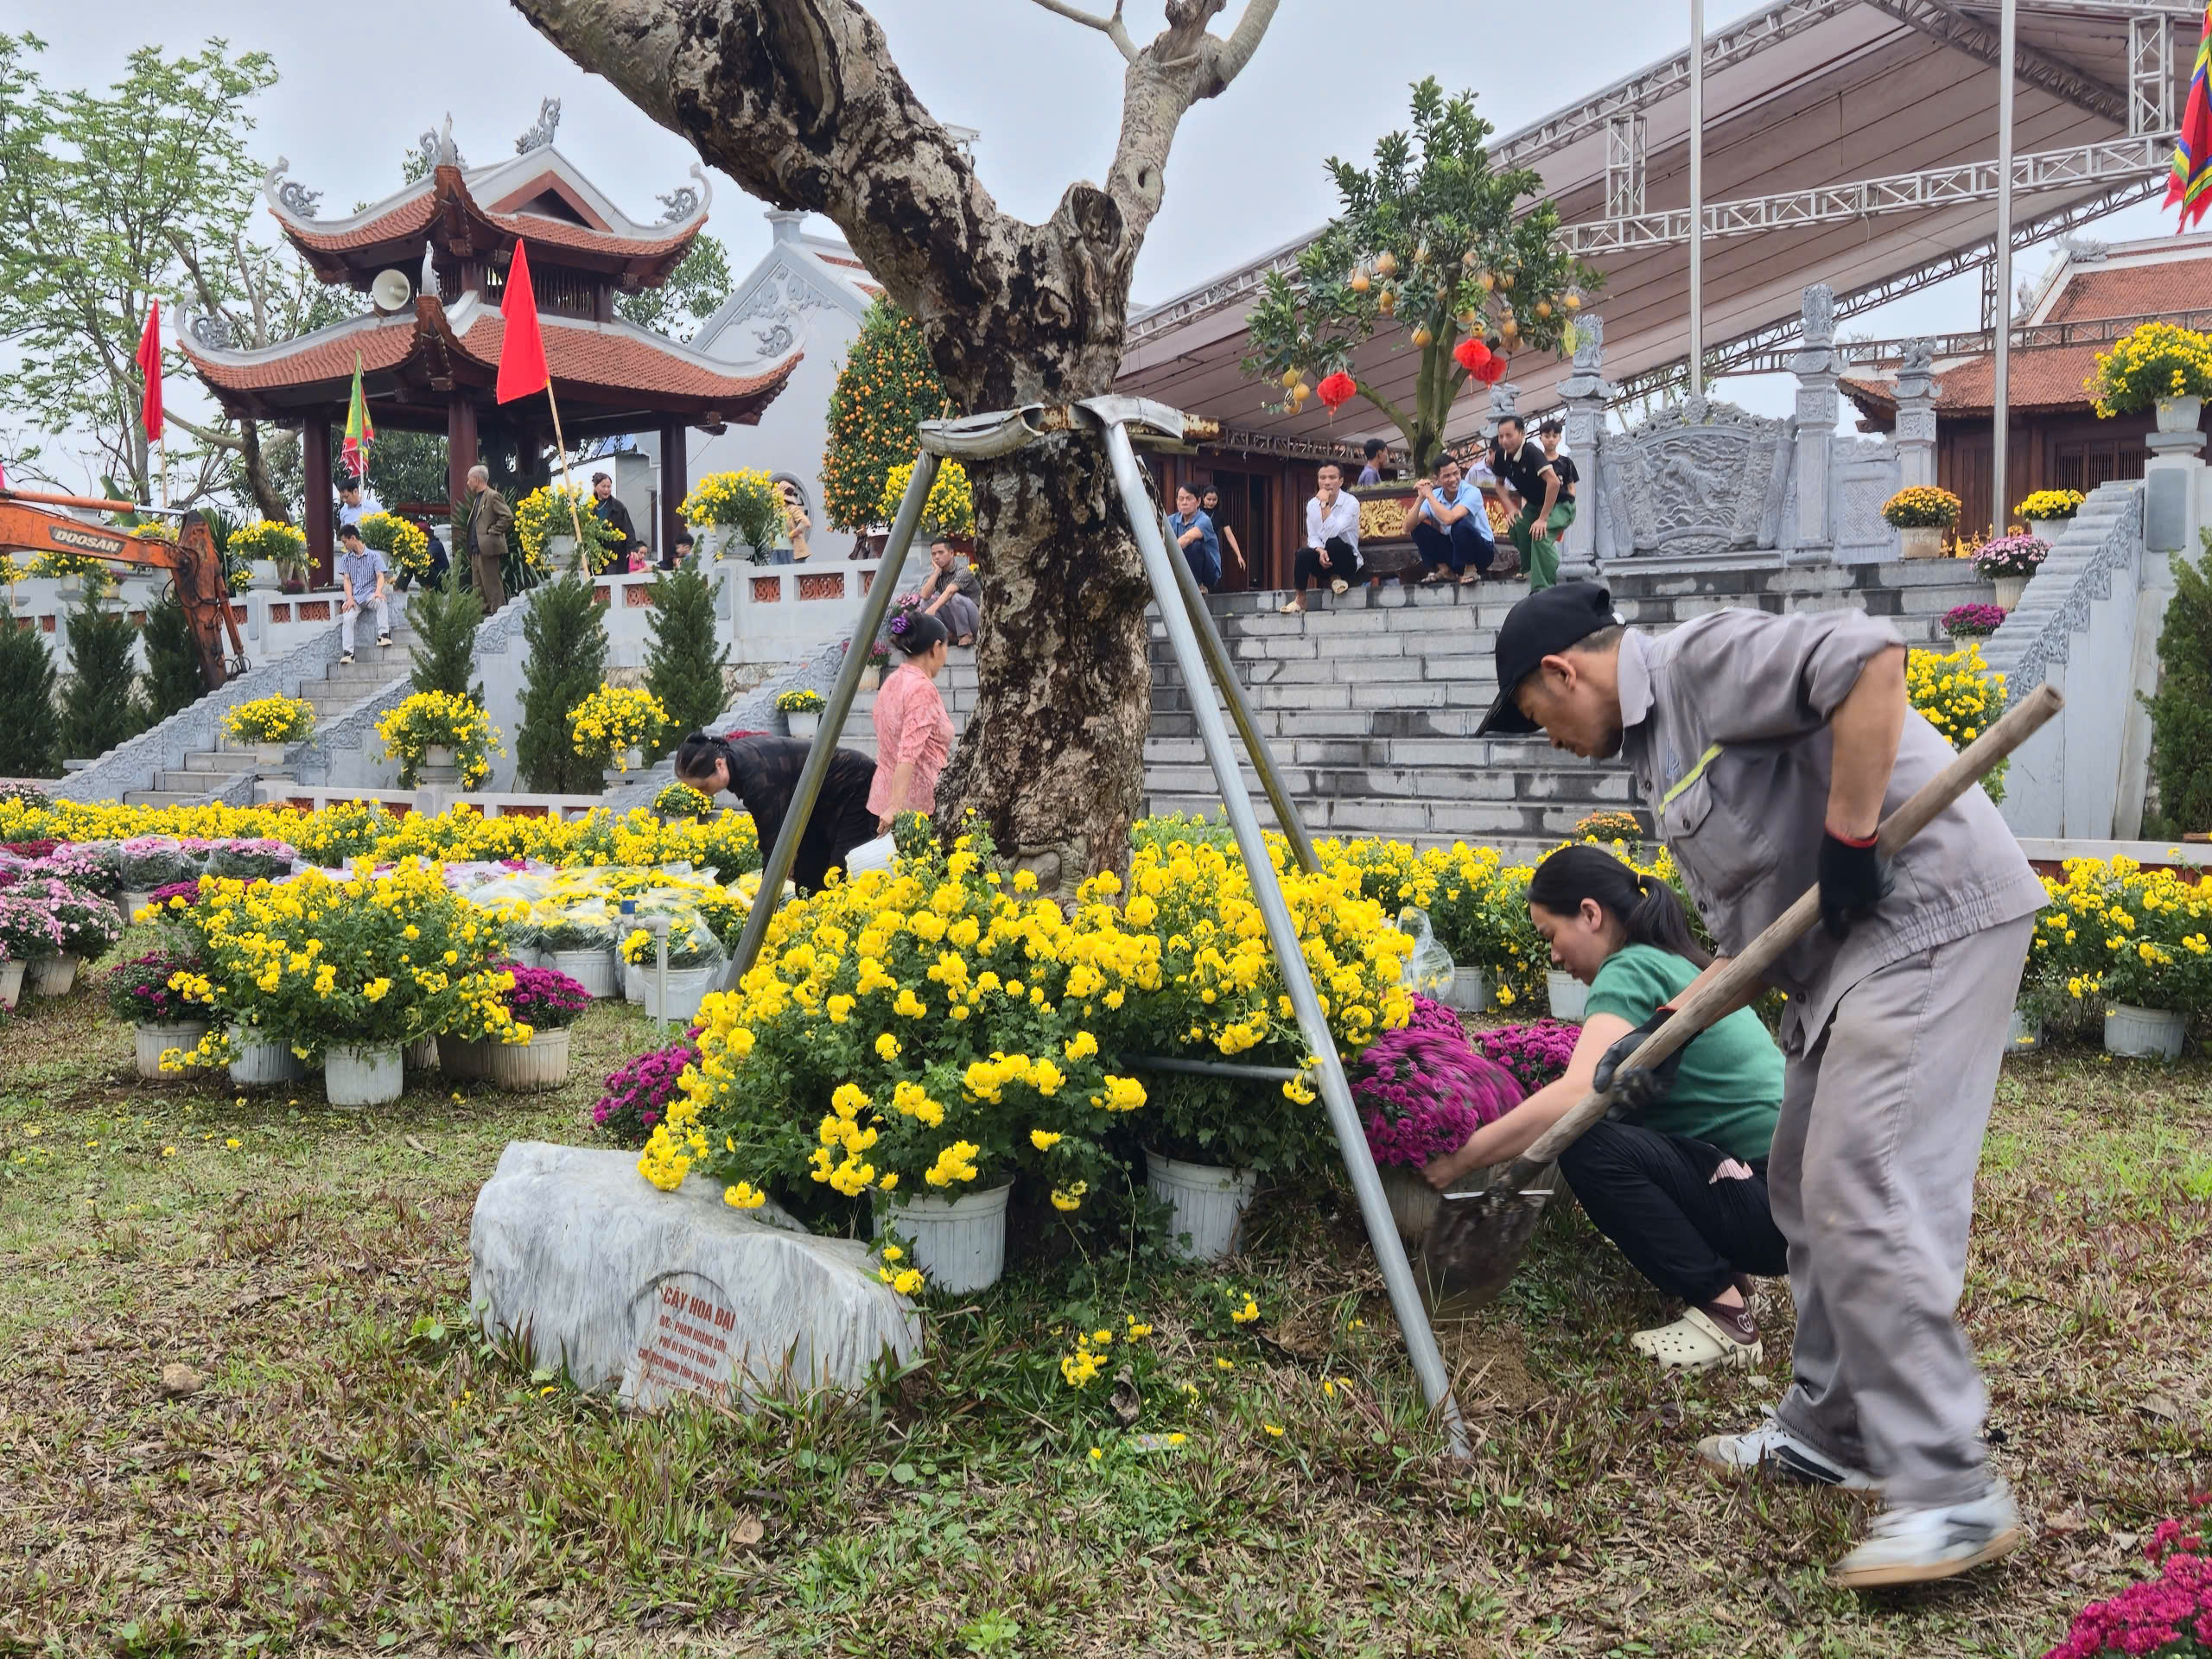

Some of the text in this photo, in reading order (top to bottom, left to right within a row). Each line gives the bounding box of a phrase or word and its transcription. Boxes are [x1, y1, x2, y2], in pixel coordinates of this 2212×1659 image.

[55, 531, 119, 552] DOOSAN
[664, 1286, 735, 1333] CÂY HOA ĐẠI
